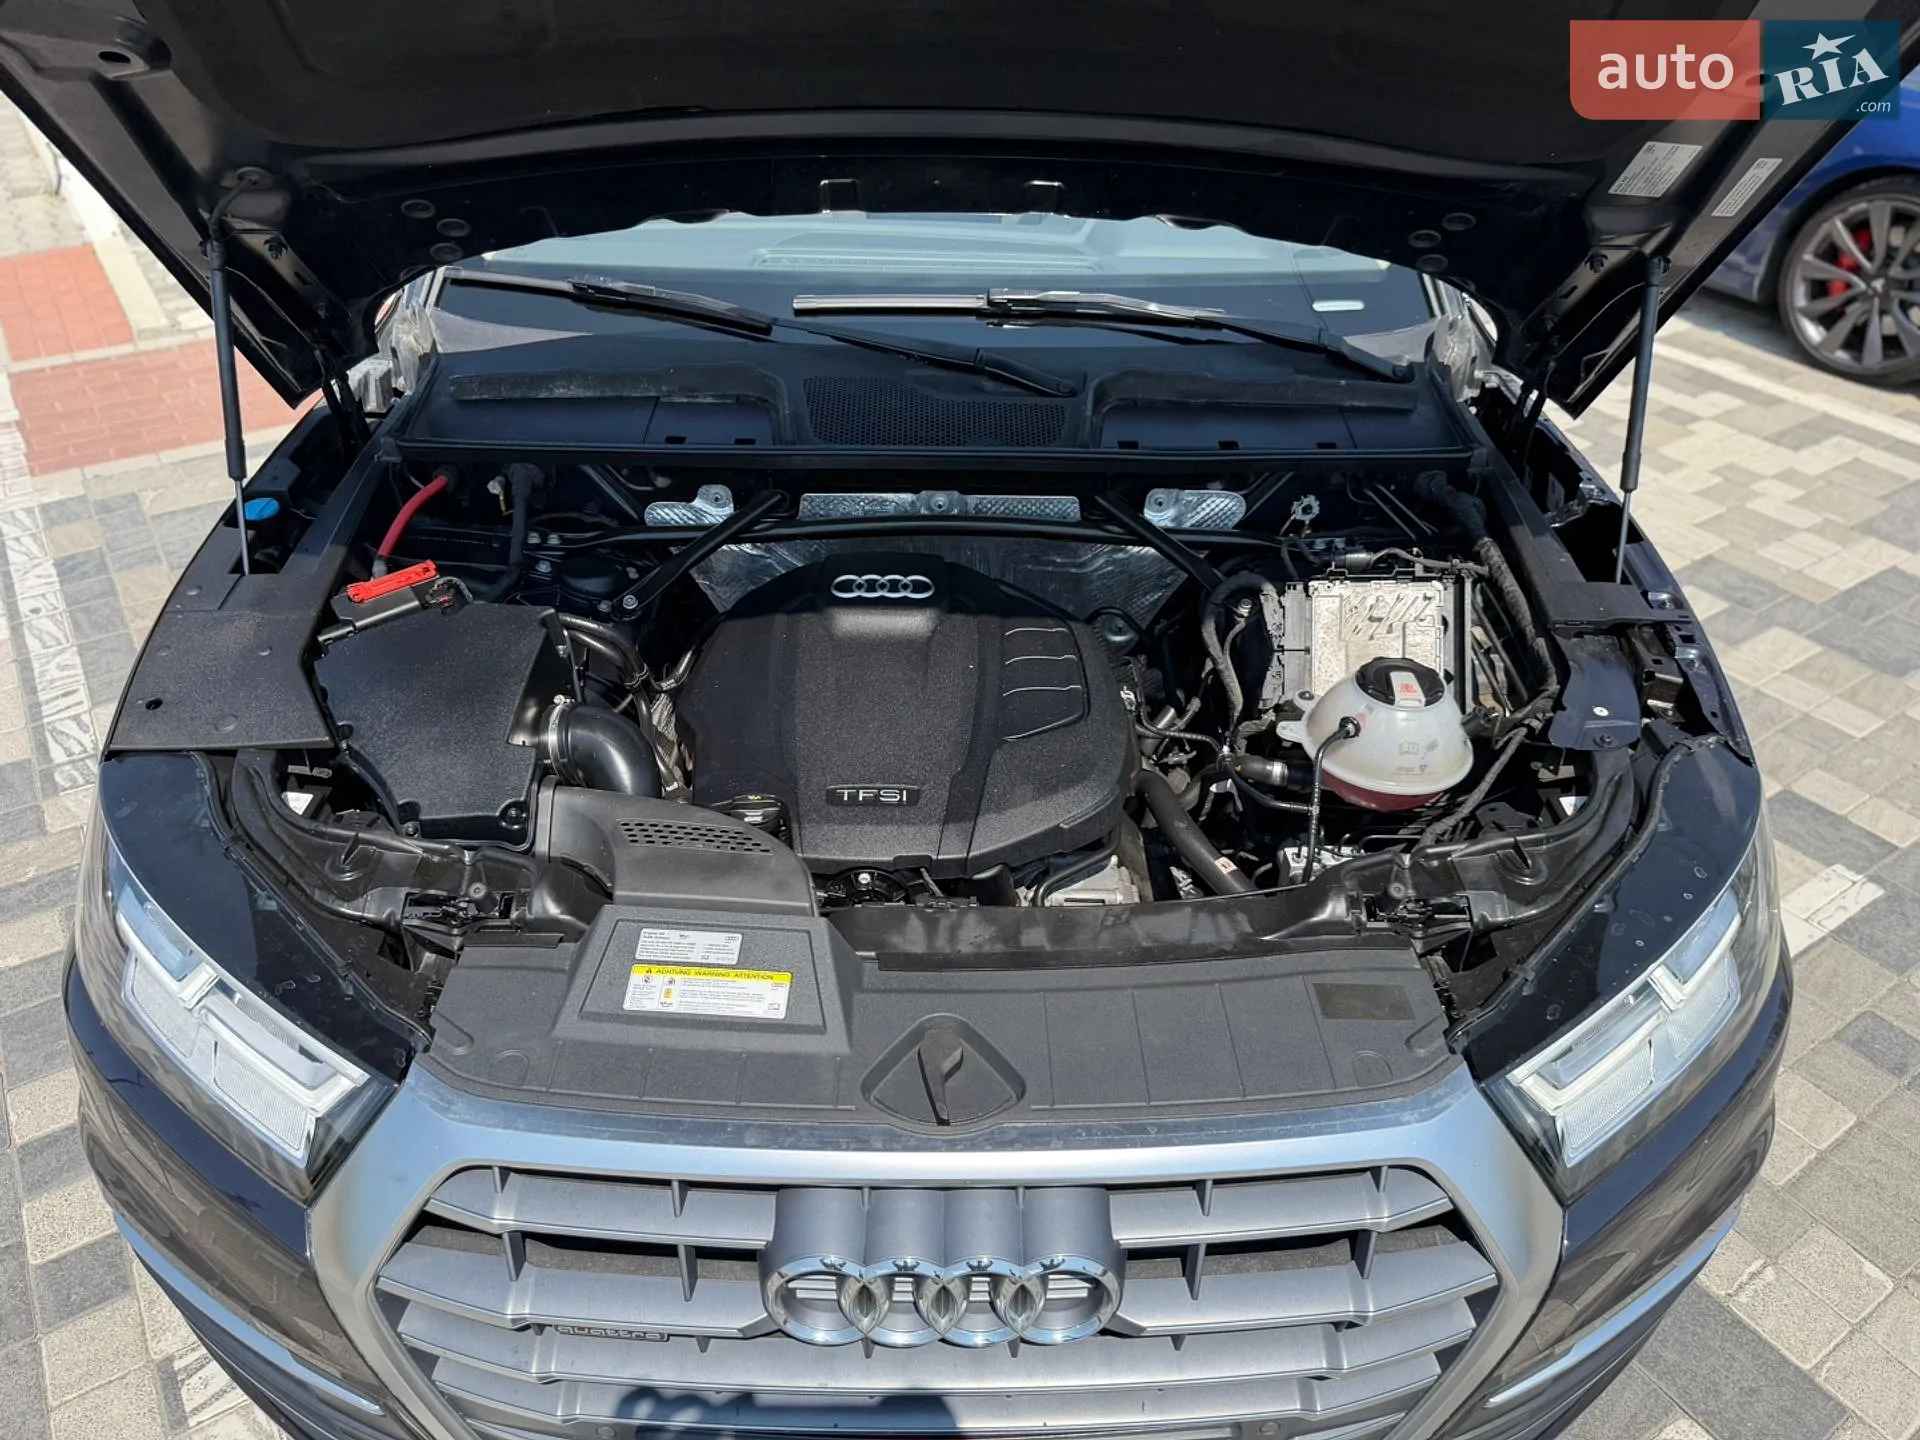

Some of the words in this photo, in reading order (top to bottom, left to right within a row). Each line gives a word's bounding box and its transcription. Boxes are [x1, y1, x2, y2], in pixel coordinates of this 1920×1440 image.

[836, 789, 907, 801] TFSI
[655, 968, 692, 976] ACHTUNG
[694, 970, 731, 978] WARNING
[733, 972, 775, 980] ATTENTION
[557, 1326, 661, 1339] quattro
